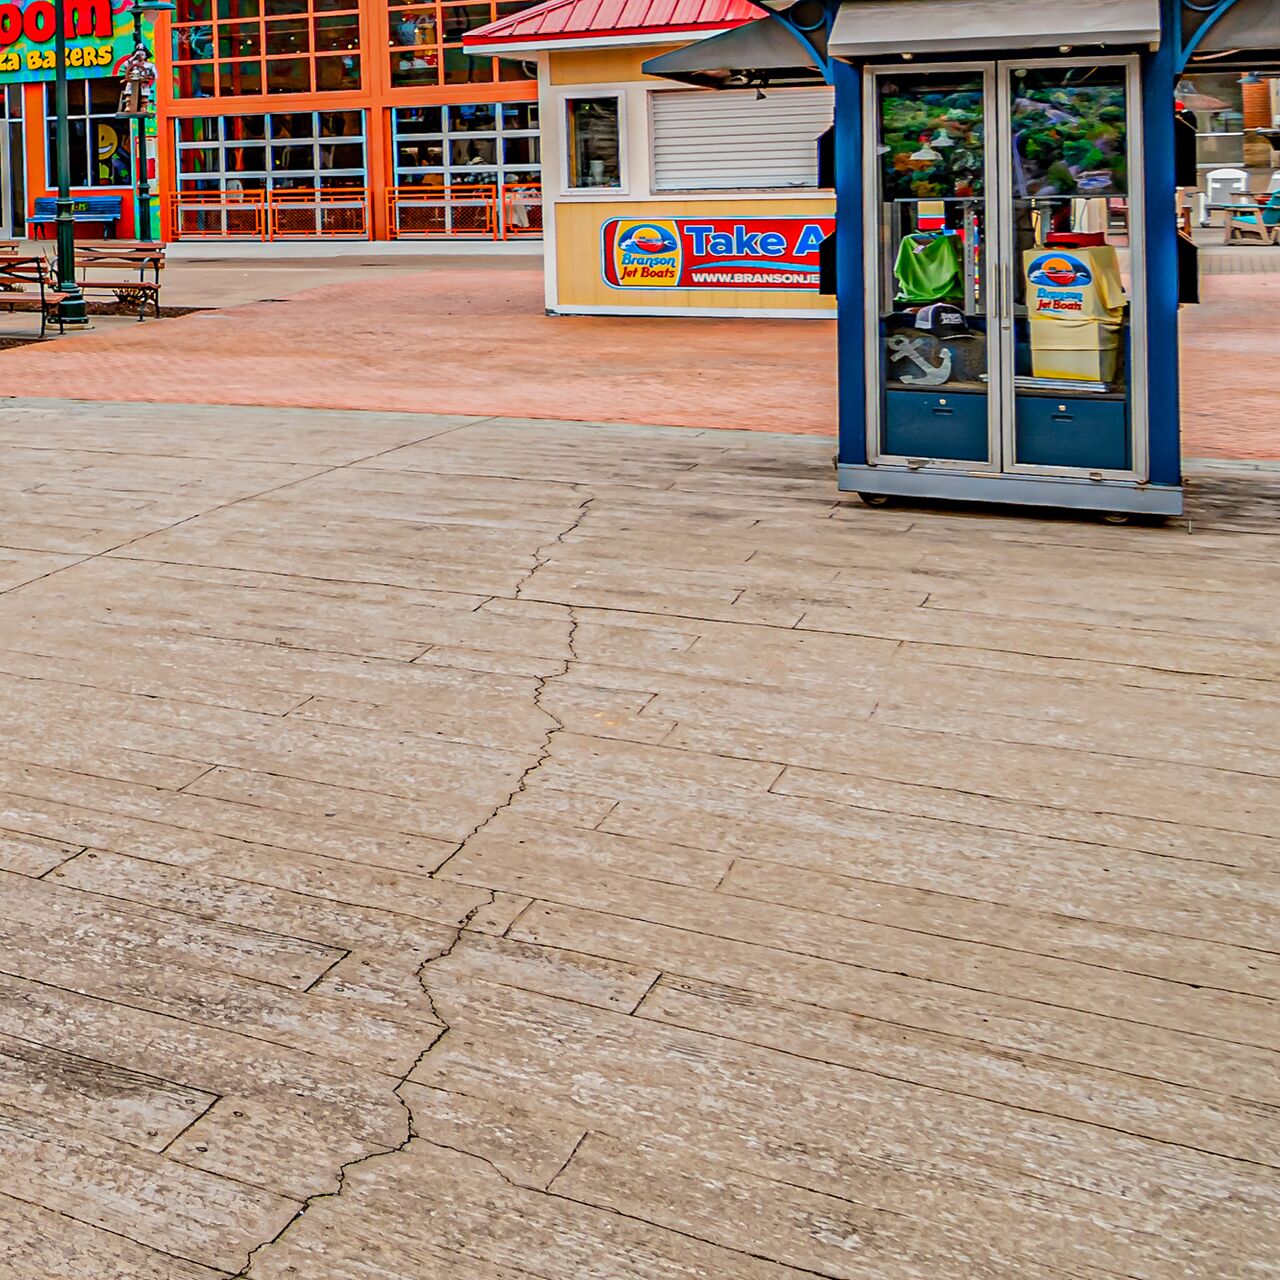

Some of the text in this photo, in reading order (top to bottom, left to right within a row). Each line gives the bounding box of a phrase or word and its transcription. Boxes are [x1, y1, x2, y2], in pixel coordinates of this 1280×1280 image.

[684, 224, 826, 257] Take A
[621, 253, 677, 268] Branson
[620, 266, 676, 280] Jet Boats
